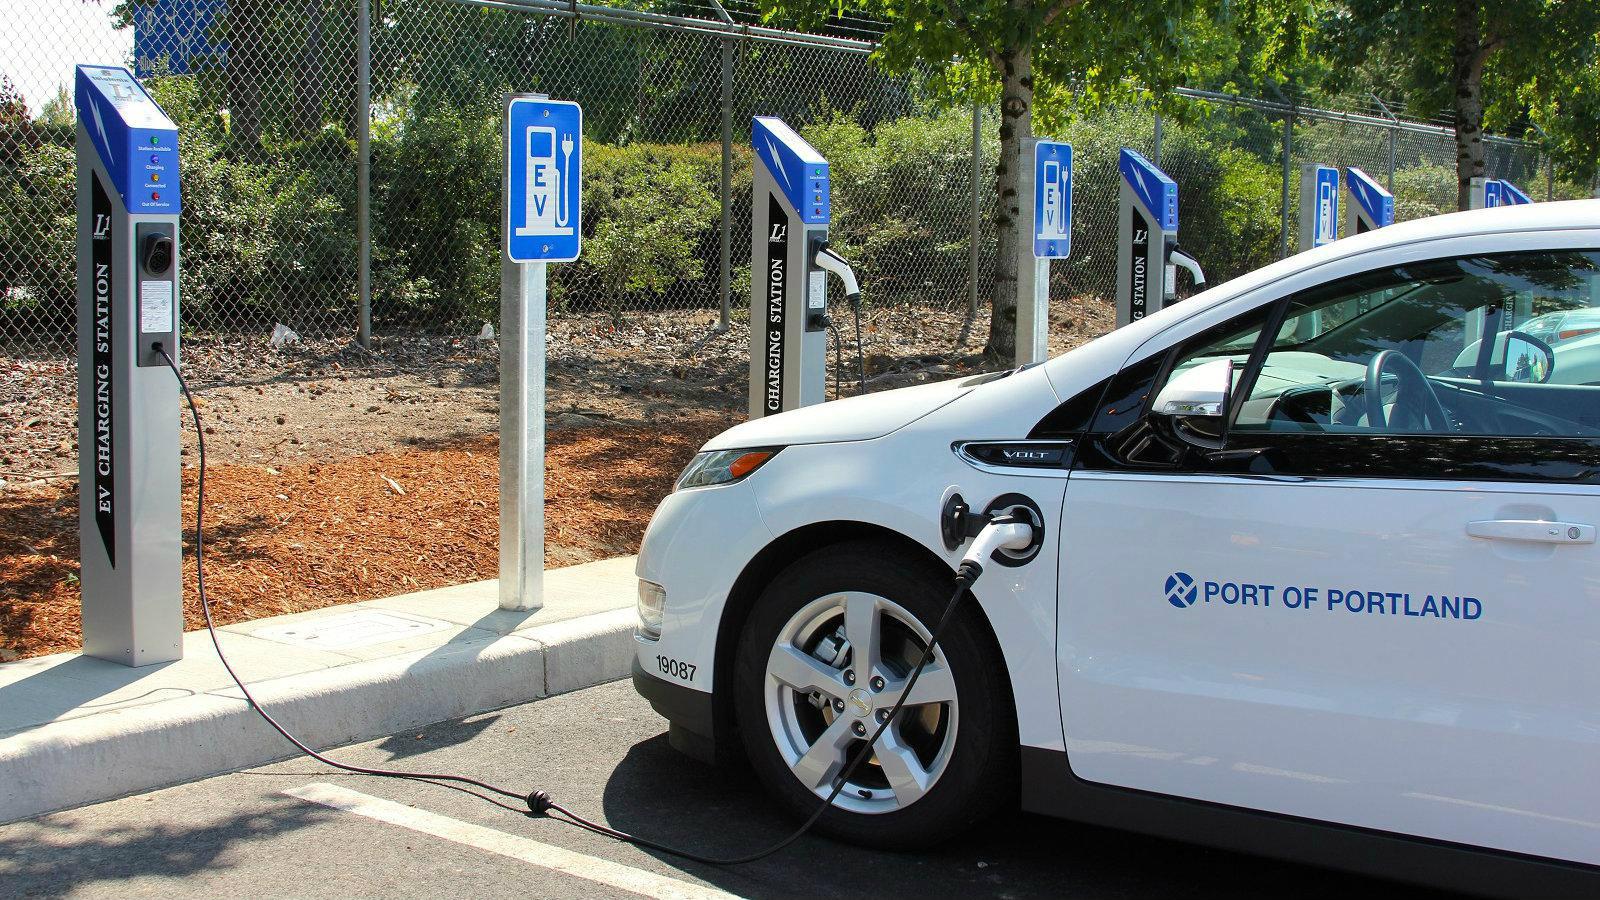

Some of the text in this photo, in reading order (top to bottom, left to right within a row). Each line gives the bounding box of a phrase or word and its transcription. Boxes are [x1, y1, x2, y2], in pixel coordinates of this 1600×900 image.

[770, 258, 783, 323] STATION
[1133, 256, 1145, 306] STATION
[1505, 295, 1514, 331] HARGIN
[96, 262, 111, 514] EV CHARGING STATION
[767, 330, 781, 411] CHARGING
[1002, 449, 1049, 459] VOLT
[1204, 581, 1482, 620] PORT OF PORTLAND
[656, 655, 697, 681] 19087
